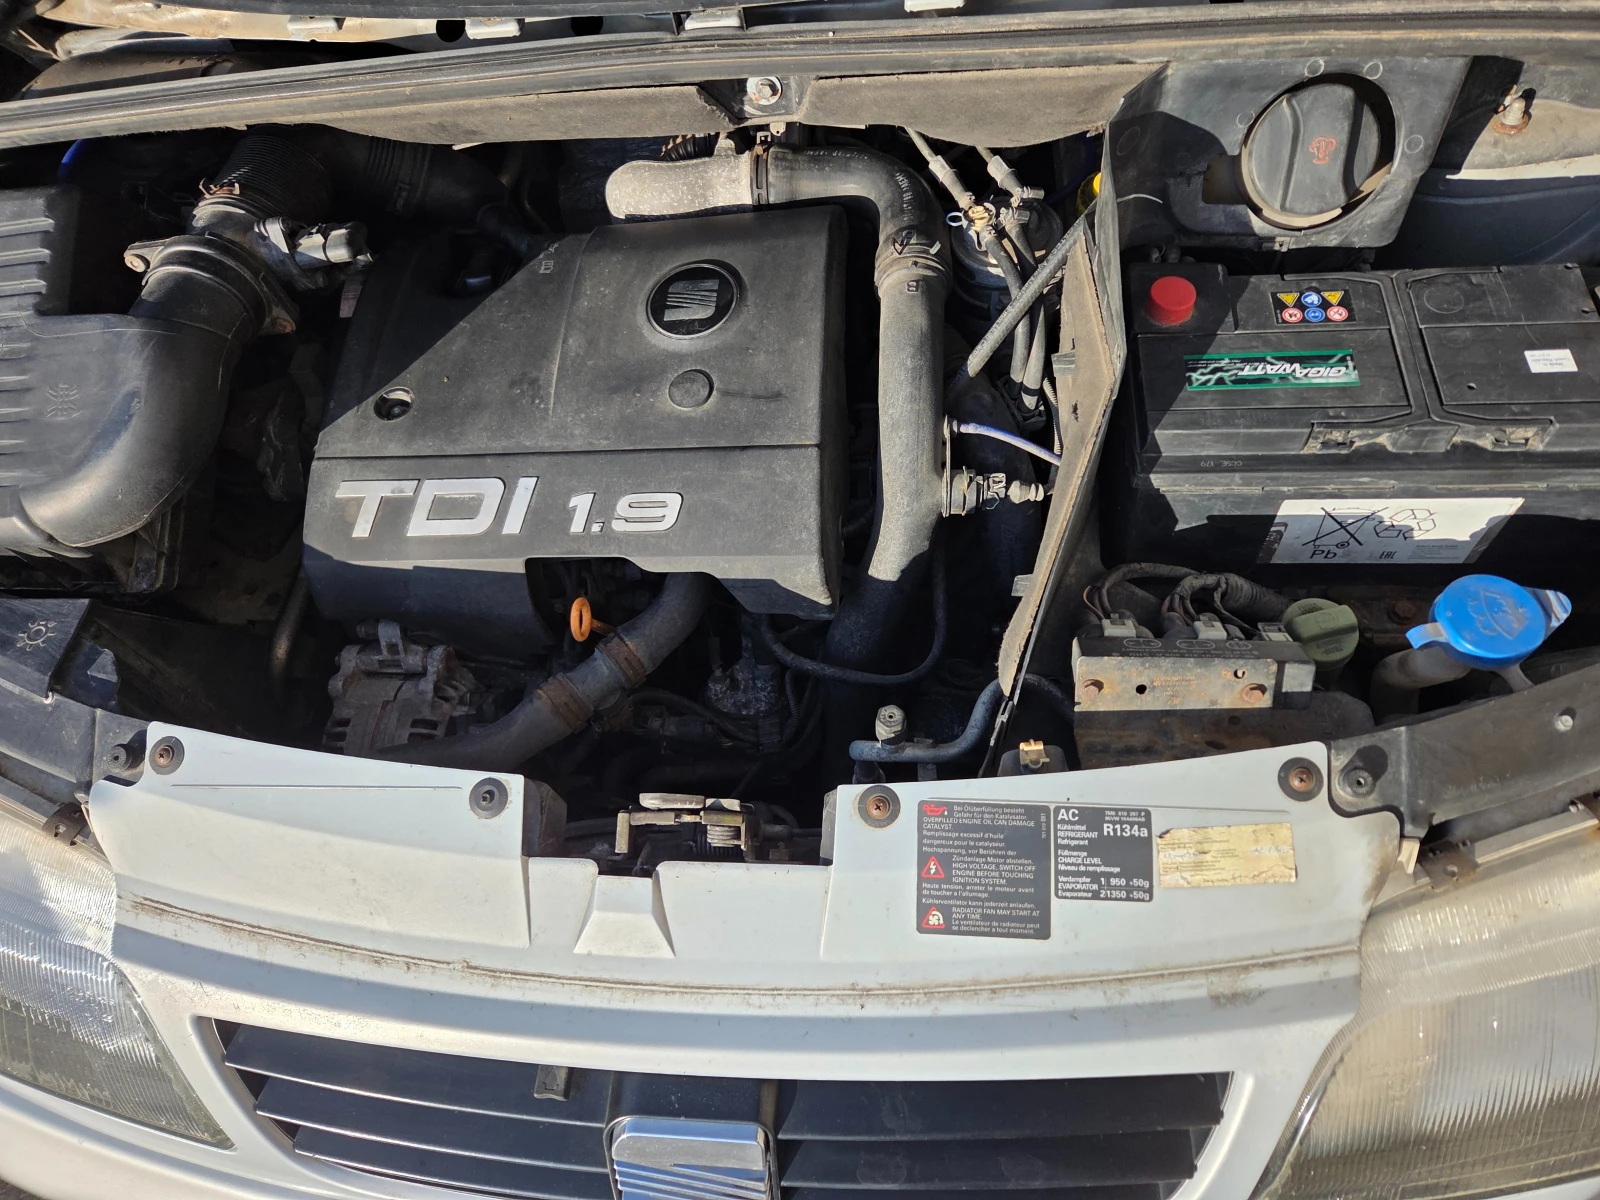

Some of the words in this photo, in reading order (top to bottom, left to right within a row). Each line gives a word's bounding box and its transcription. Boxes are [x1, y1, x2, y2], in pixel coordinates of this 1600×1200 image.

[1238, 362, 1347, 378] GIGAWATT
[335, 476, 538, 538] TDI
[568, 492, 683, 534] 1.9
[1310, 550, 1337, 559] Pb
[1057, 808, 1079, 821] AC
[1103, 823, 1148, 837] R134a
[1087, 865, 1120, 873] remplissage
